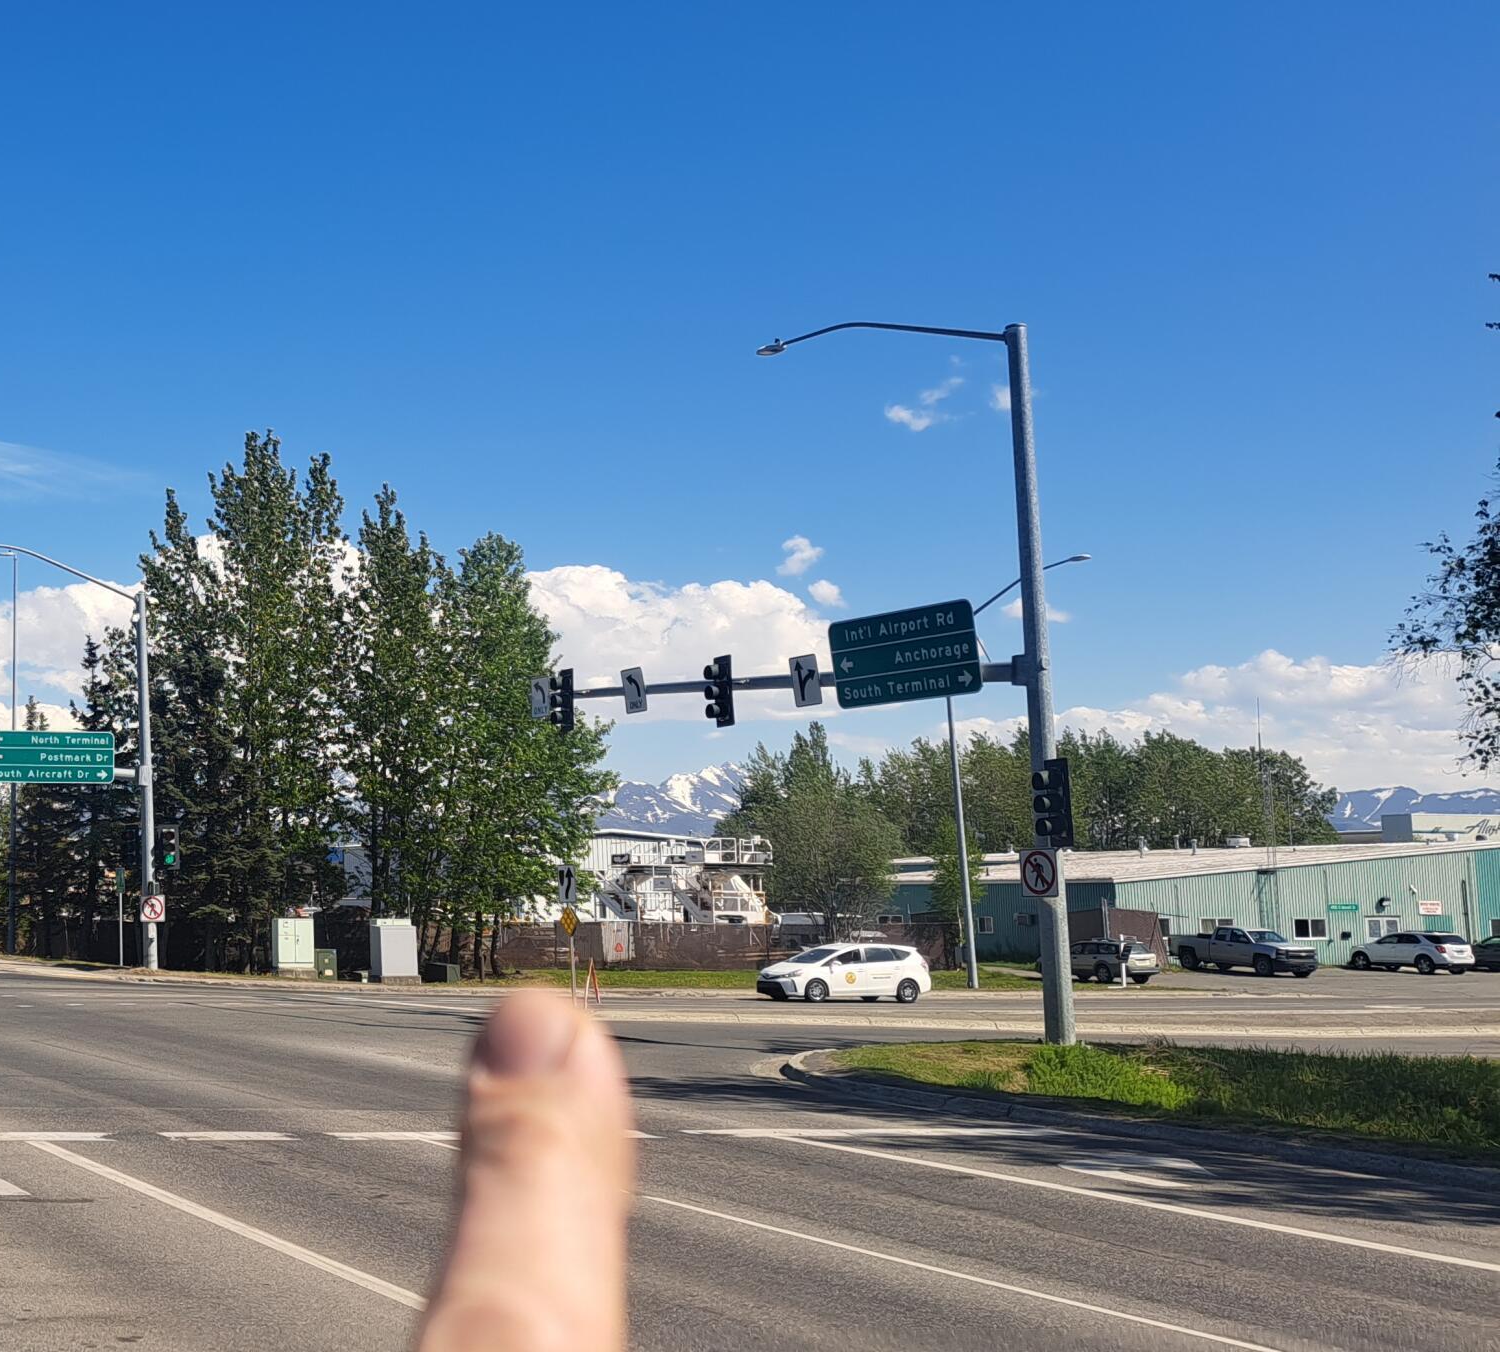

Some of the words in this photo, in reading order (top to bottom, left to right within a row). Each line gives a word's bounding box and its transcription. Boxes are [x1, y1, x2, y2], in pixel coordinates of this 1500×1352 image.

[845, 626, 872, 642] Int'l
[879, 615, 929, 637] Airport
[936, 611, 954, 627] Rd
[895, 643, 969, 665] Anchorage
[844, 684, 882, 700] South
[887, 674, 950, 695] Terminal
[31, 735, 60, 744] North
[65, 735, 109, 745] Terminal
[40, 752, 91, 762] Postmark
[96, 753, 109, 762] Dr
[27, 769, 72, 778] Aircraft
[77, 770, 90, 779] Dr
